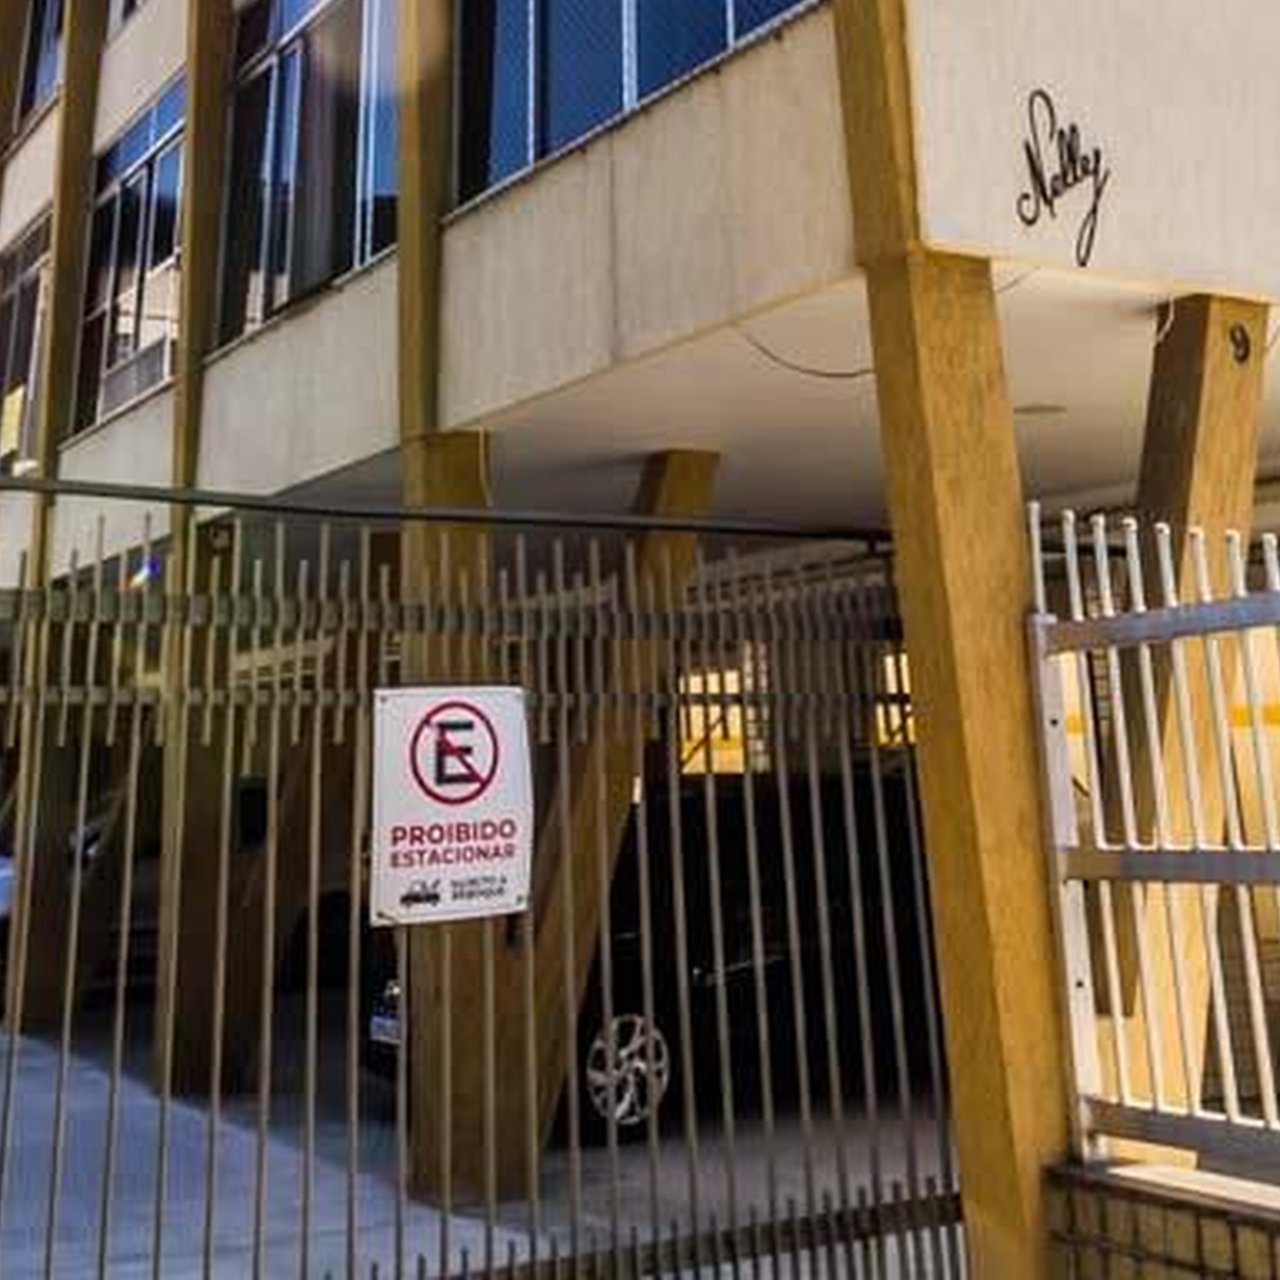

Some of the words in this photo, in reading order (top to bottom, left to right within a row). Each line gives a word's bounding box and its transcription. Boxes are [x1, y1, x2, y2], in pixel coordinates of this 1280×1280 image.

[1229, 322, 1250, 363] 9
[435, 720, 474, 785] E
[390, 819, 517, 847] PROIBIDO
[389, 842, 515, 869] ESTACIONAR
